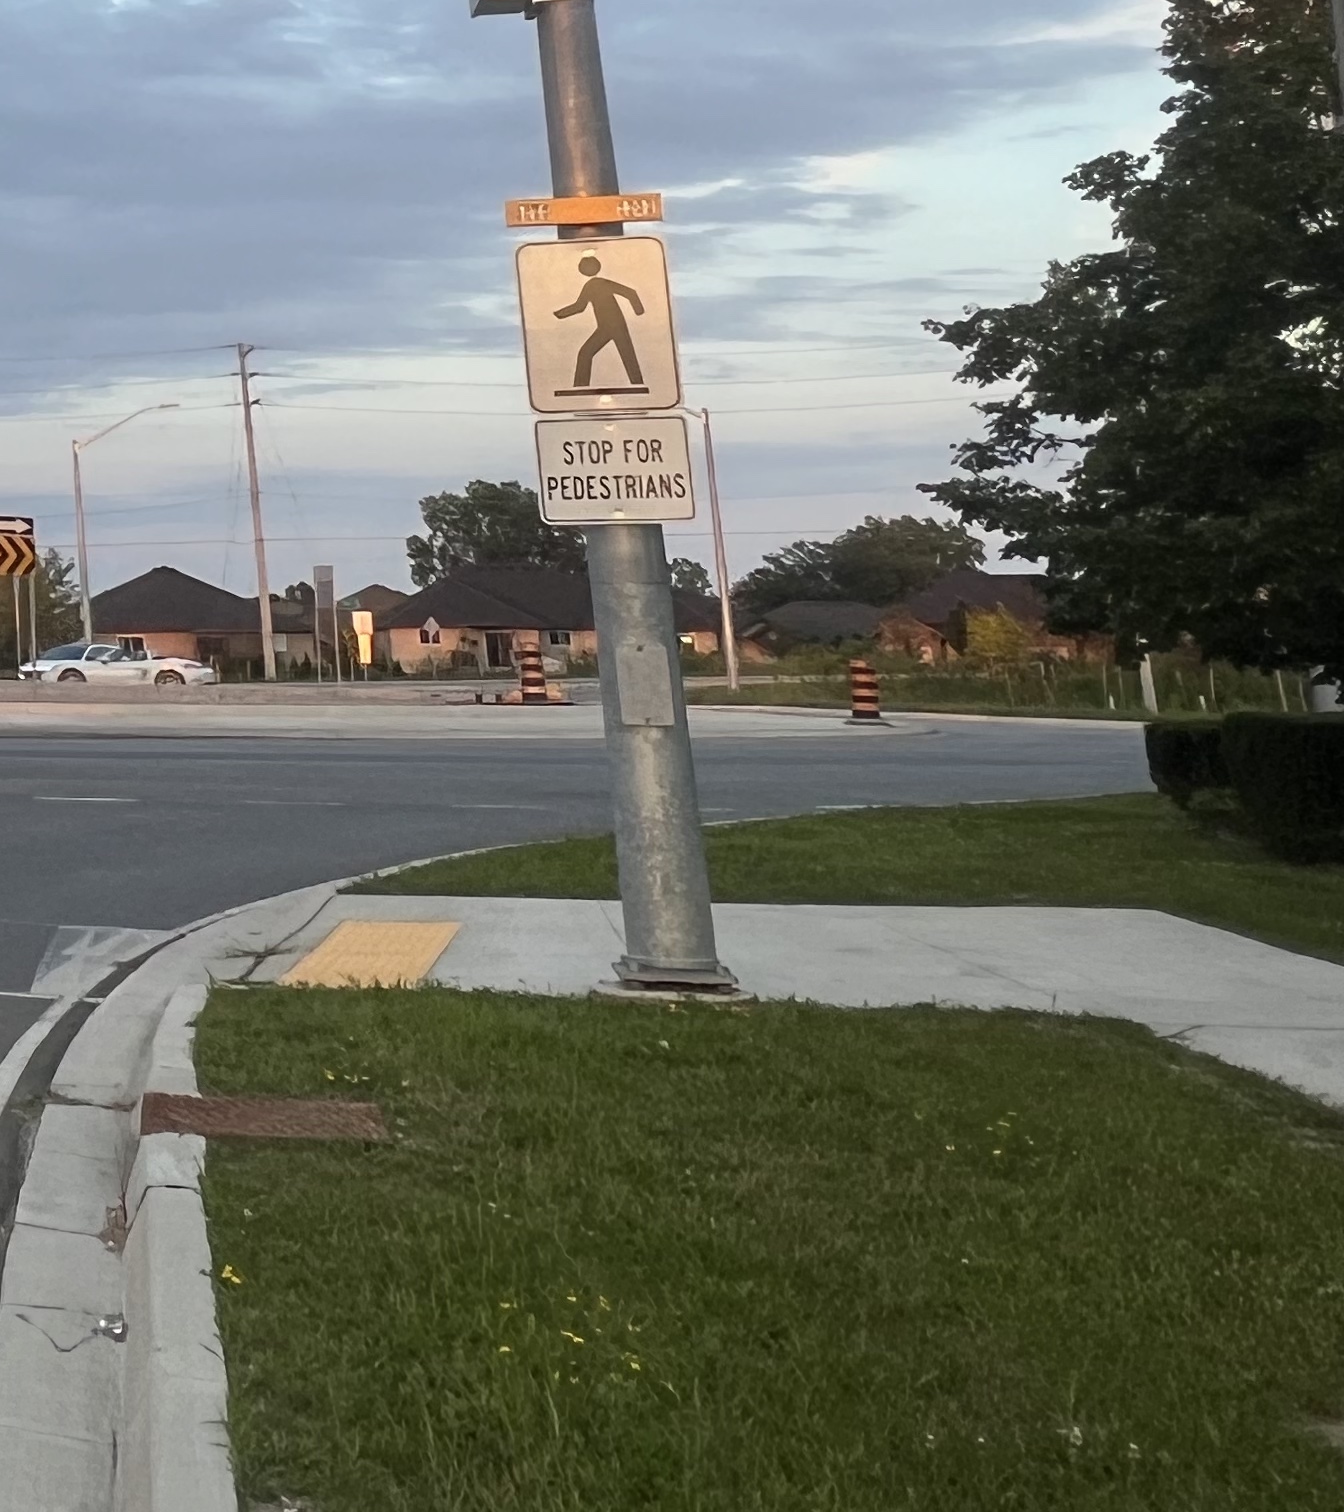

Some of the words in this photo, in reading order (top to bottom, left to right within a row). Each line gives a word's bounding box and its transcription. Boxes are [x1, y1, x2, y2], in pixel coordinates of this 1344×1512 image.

[563, 440, 613, 466] STOP
[623, 439, 664, 464] FOR
[547, 473, 686, 501] PEDESTRIANS
